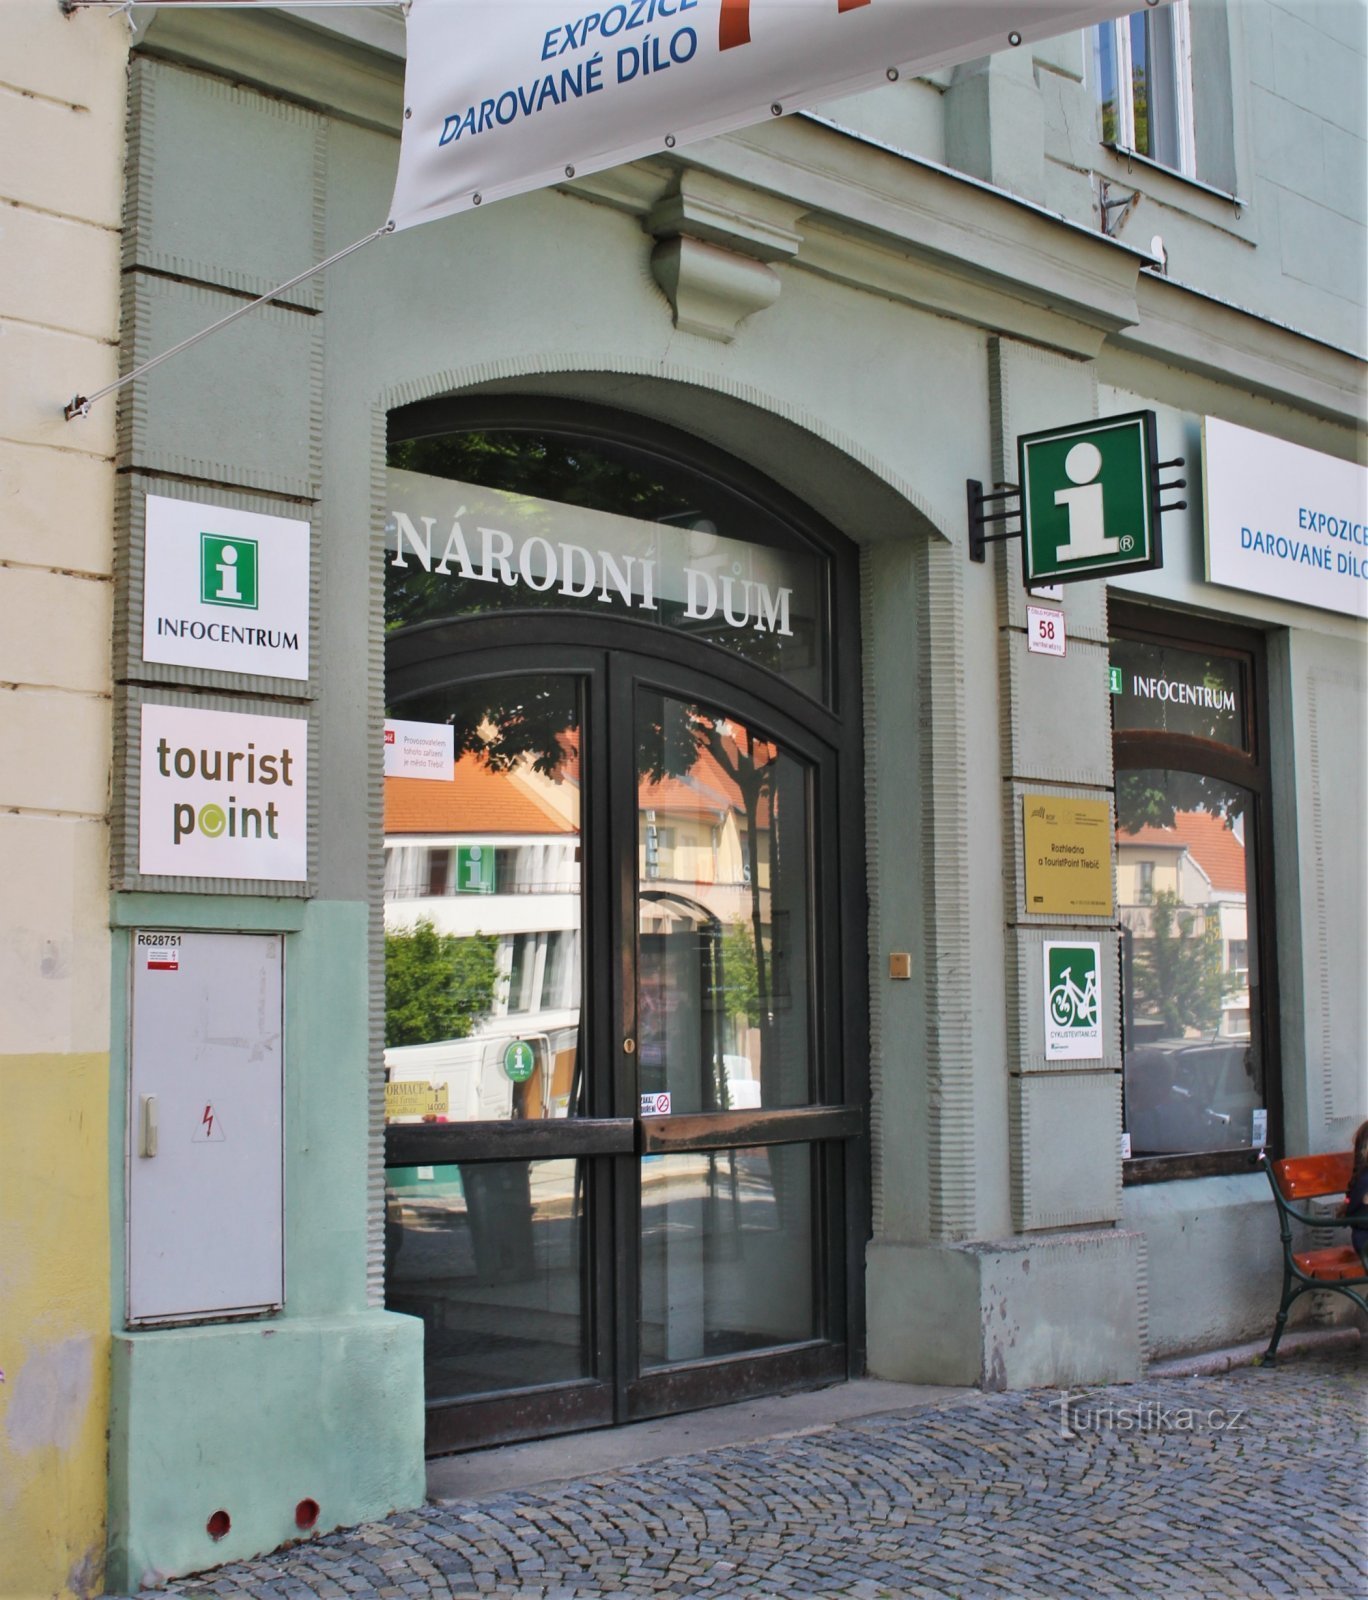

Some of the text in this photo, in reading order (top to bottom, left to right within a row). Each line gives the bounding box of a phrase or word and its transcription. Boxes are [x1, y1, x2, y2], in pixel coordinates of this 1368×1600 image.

[438, 26, 698, 147] DAROVANÉ DÍLO
[1241, 526, 1332, 571] DAROVANÉ
[391, 505, 794, 637] NÁRODNÍ DŮM
[157, 617, 299, 650] INFOCENTRUM
[1039, 620, 1055, 640] 58
[1133, 675, 1236, 712] INFOCENTRUM
[157, 738, 294, 787] tourist
[173, 796, 279, 845] point
[1038, 857, 1044, 866] a
[1044, 857, 1080, 868] TouristPoint
[1051, 843, 1085, 855] Rozhledna
[138, 934, 182, 946] R628751
